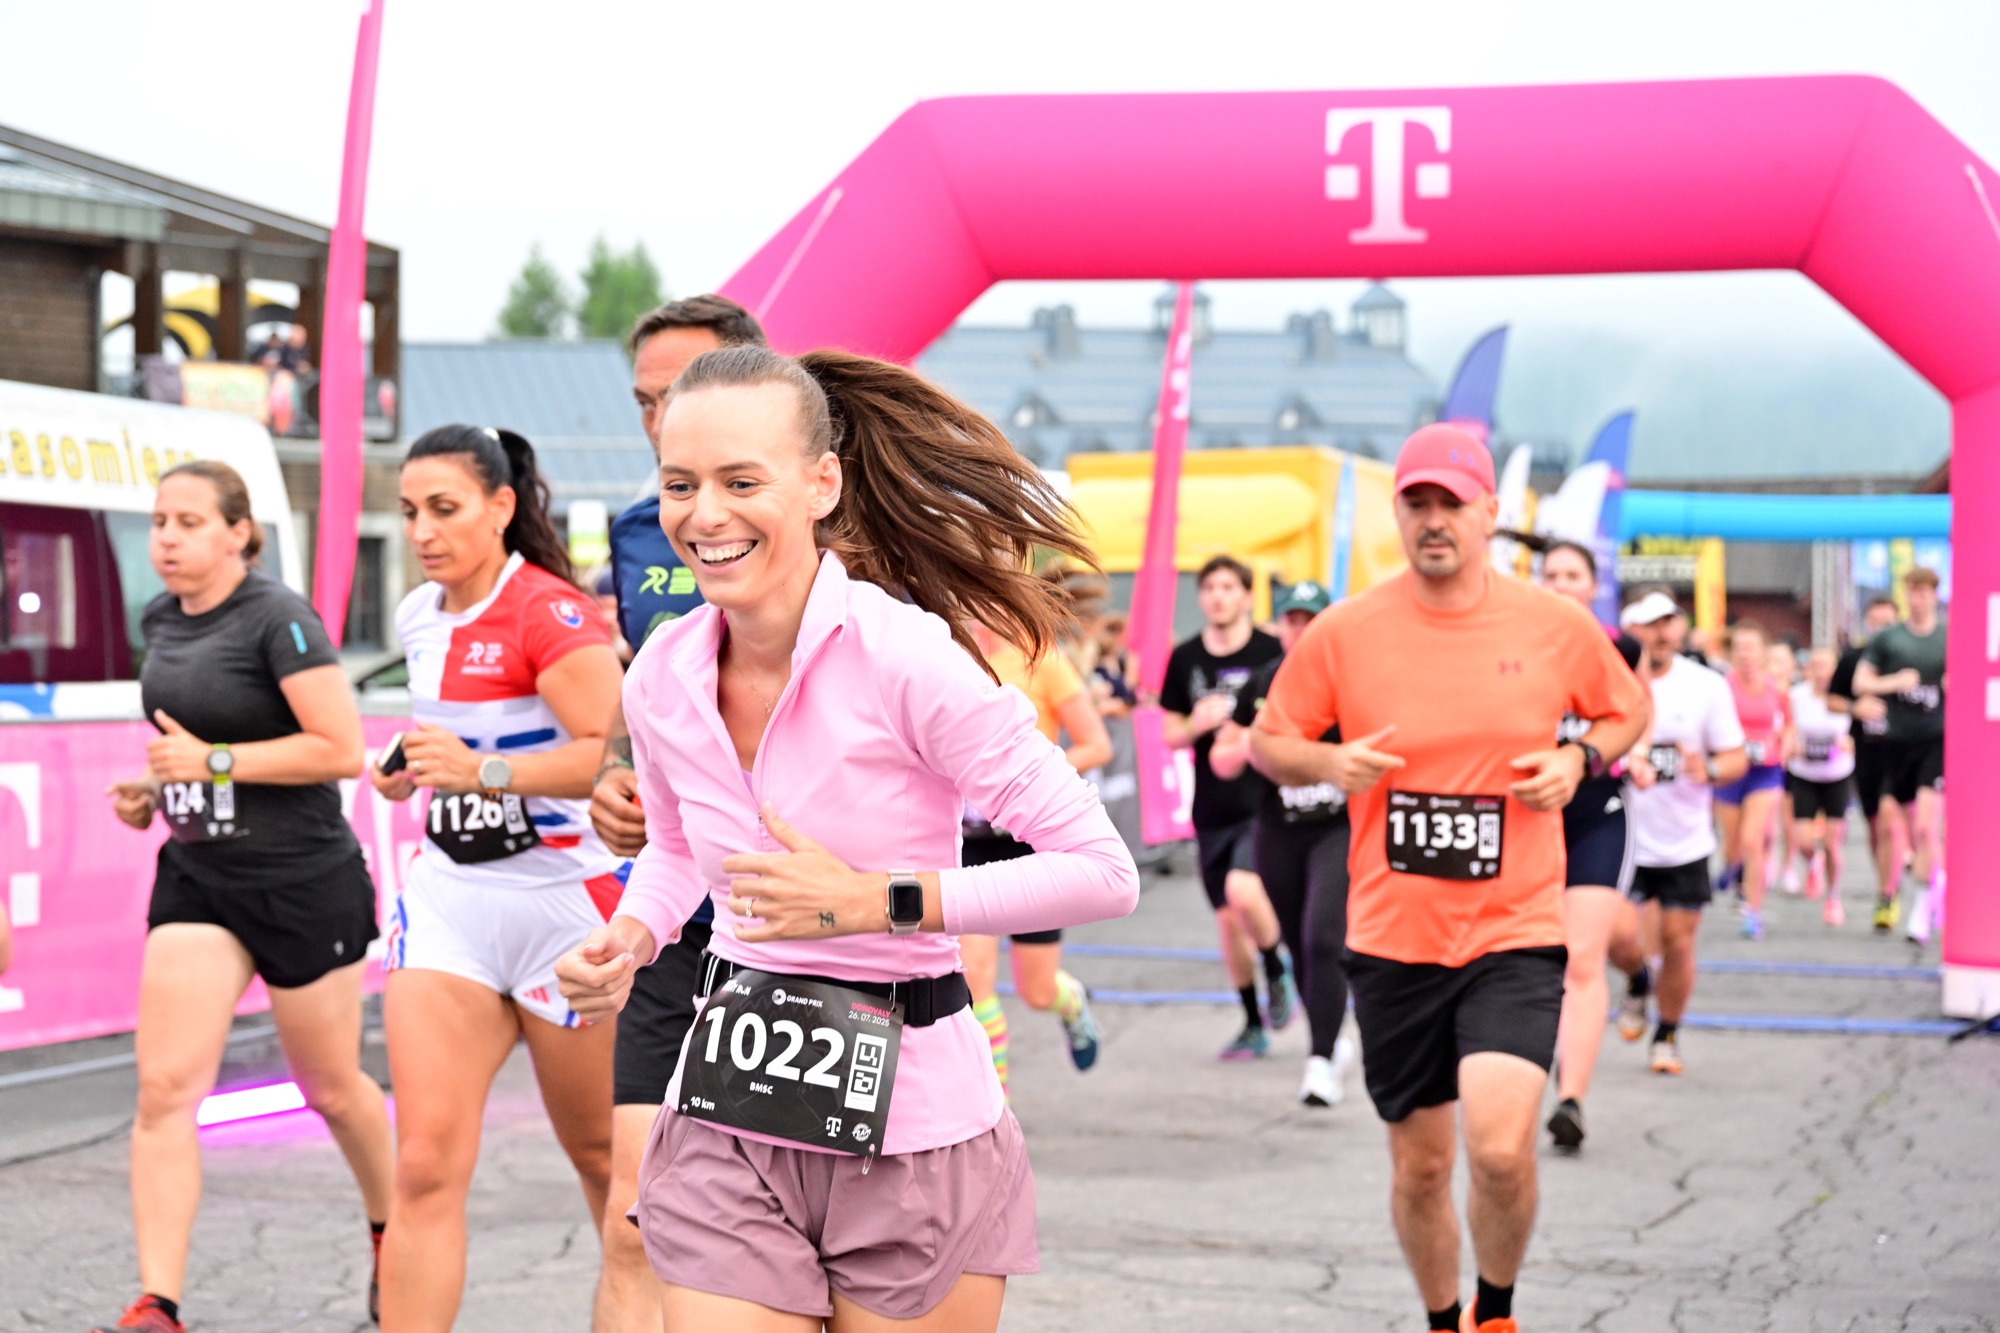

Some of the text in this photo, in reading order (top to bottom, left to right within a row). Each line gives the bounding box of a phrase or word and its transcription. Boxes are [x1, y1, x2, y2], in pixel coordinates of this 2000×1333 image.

[1325, 106, 1452, 244] T
[1388, 810, 1478, 850] 1133
[786, 994, 823, 1008] GRAND PRIX
[851, 1002, 891, 1018] DONOVALY
[871, 1015, 890, 1027] 2025
[704, 1005, 846, 1090] 1022
[749, 1081, 774, 1095] BMSC
[690, 1096, 715, 1111] 10 km
